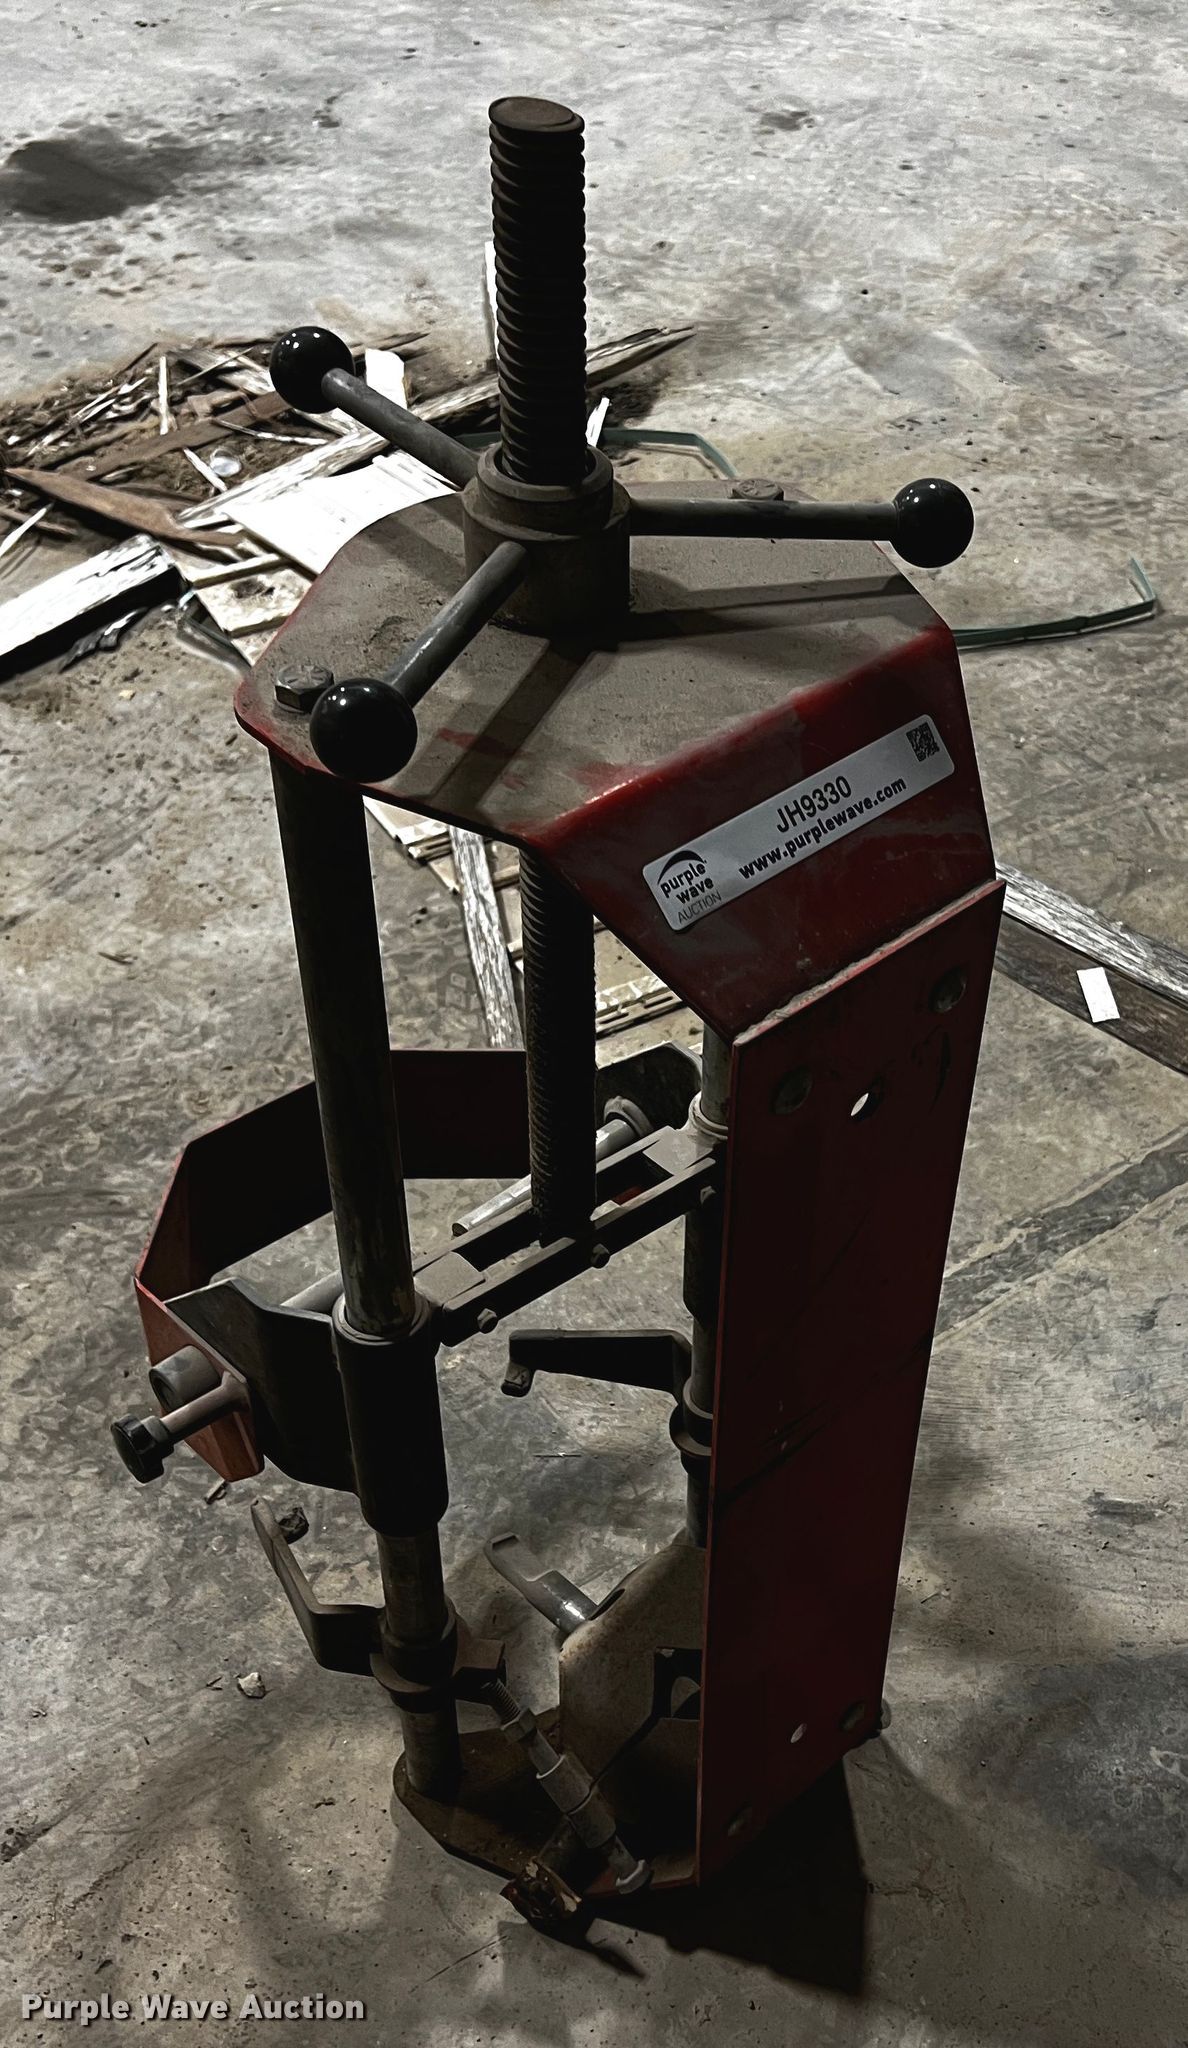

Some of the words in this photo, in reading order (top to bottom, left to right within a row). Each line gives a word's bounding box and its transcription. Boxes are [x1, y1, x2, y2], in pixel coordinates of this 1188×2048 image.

[776, 775, 852, 833] JH9330
[739, 776, 907, 879] www.purplewave.com
[660, 861, 705, 898] purple
[676, 877, 714, 904] wave
[677, 891, 721, 923] AUCTION
